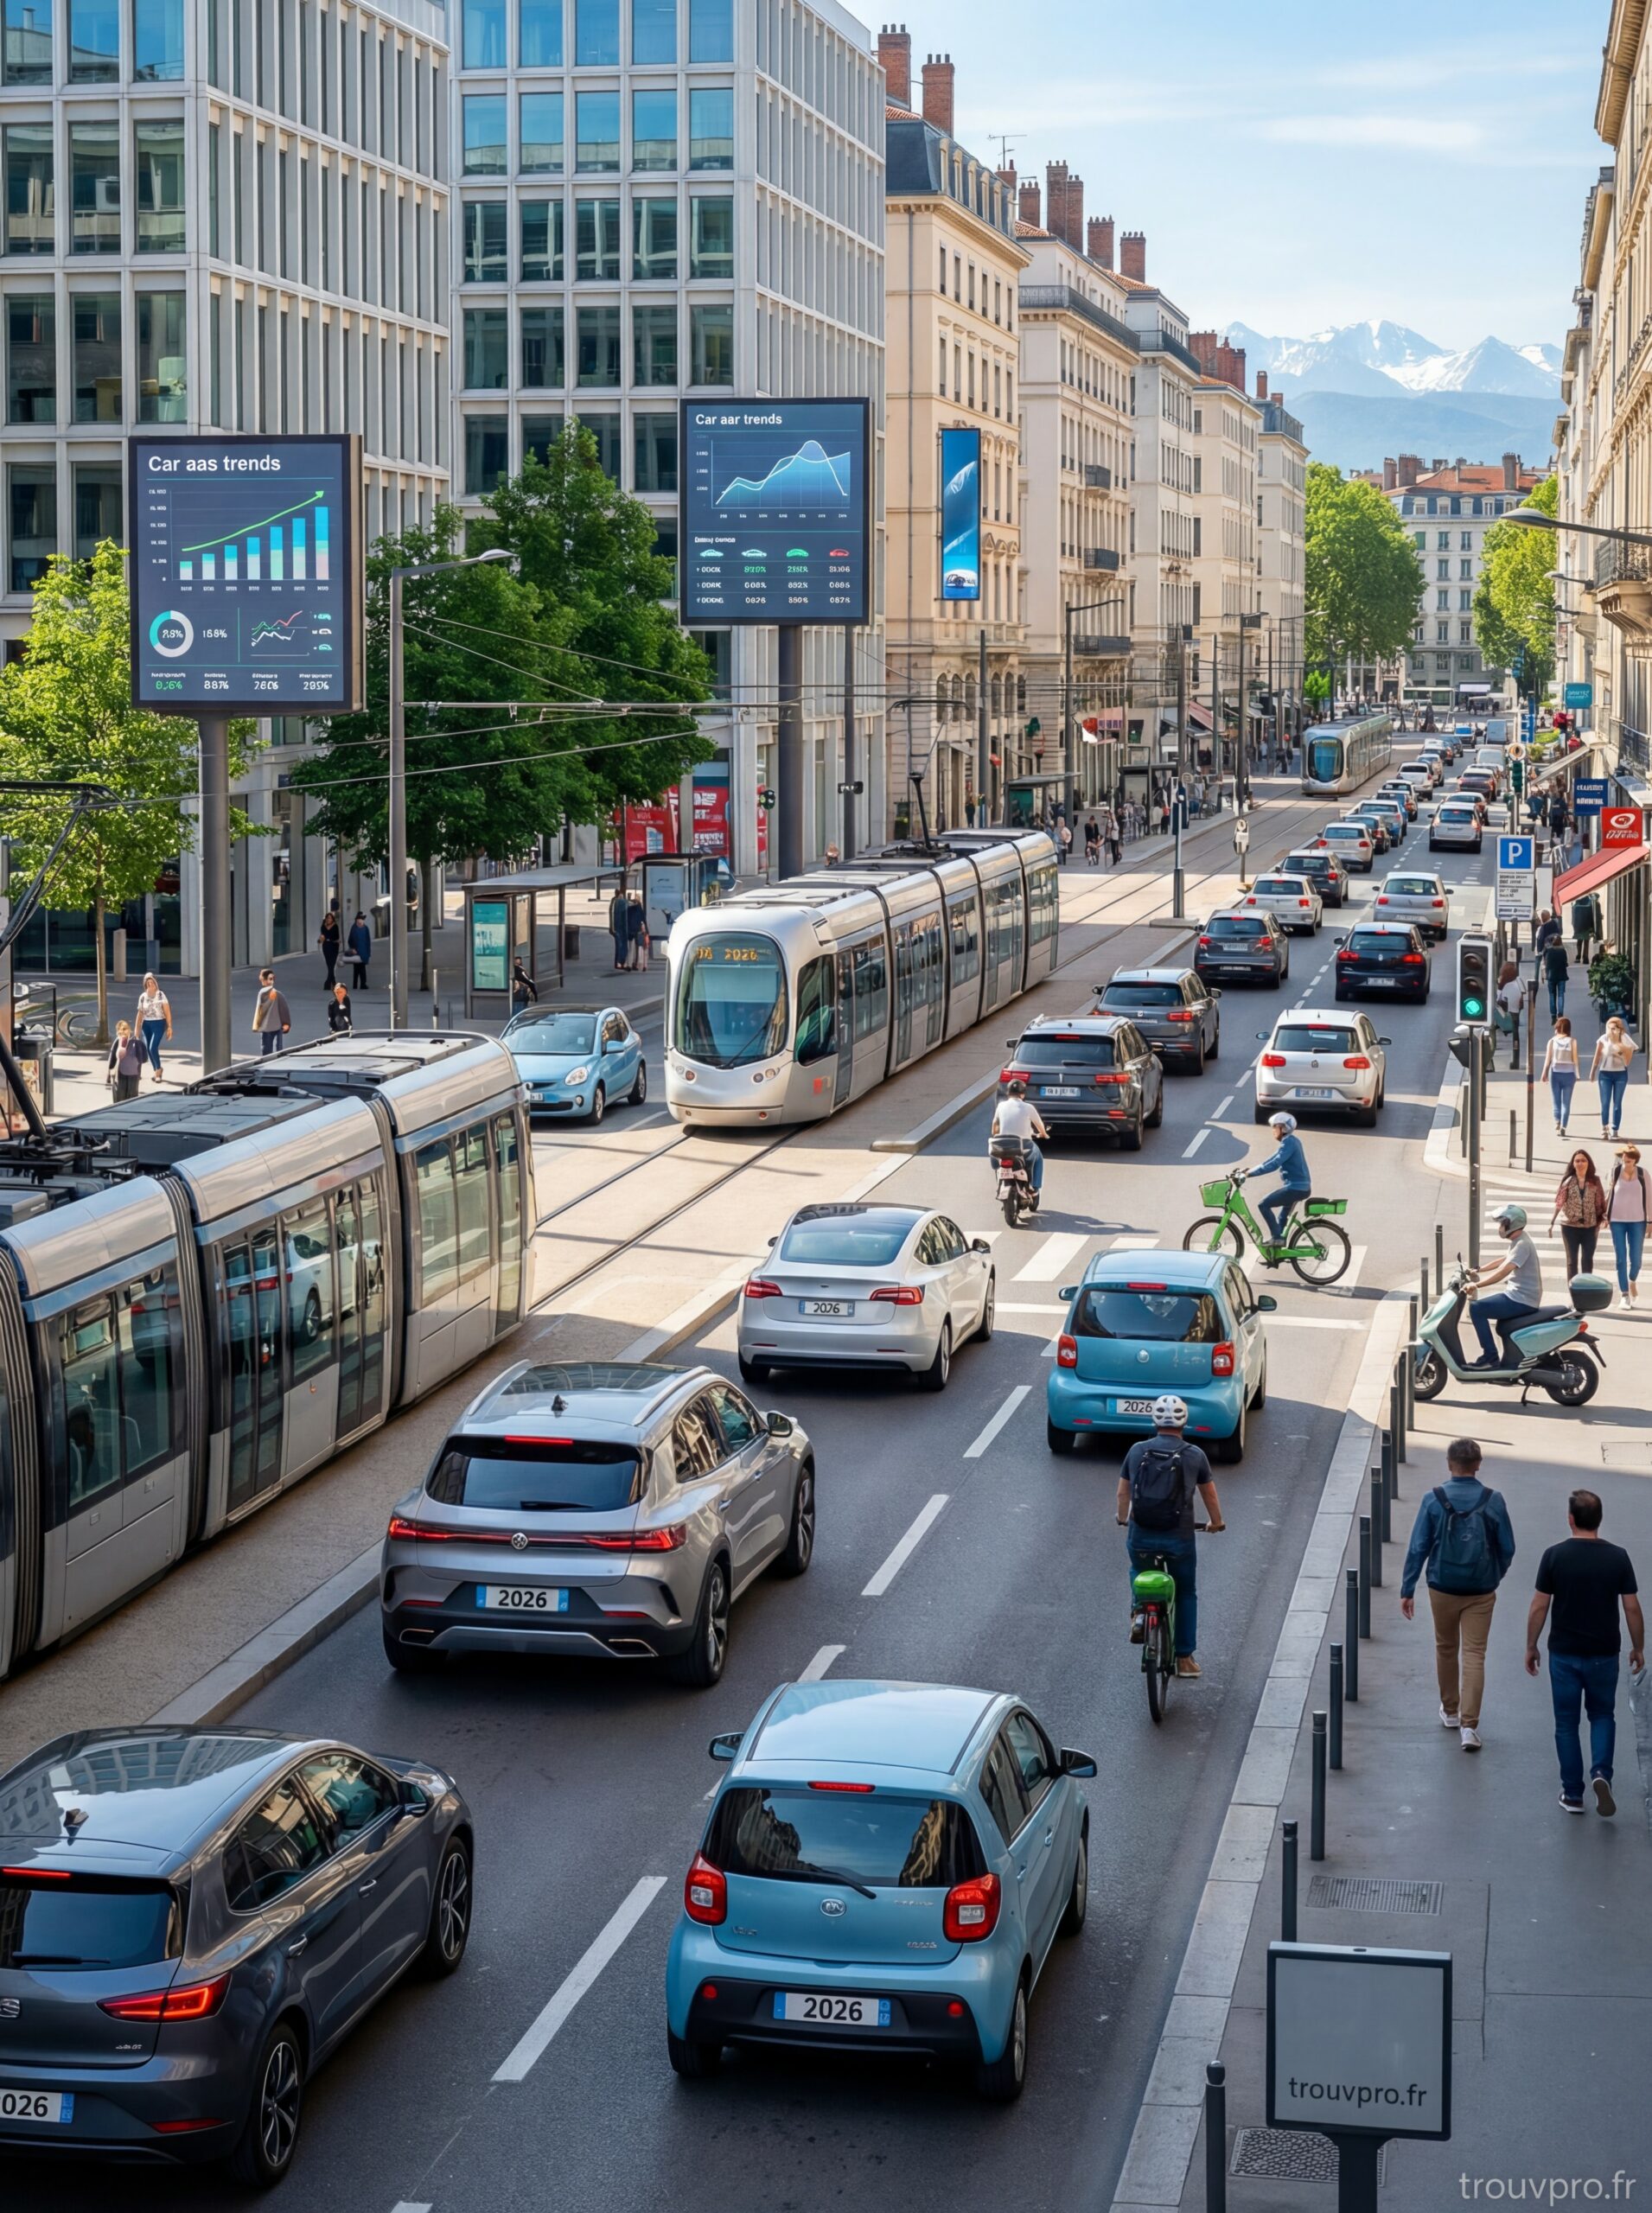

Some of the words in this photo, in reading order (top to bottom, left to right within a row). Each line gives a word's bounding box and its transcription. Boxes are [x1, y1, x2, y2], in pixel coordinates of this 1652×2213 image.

[695, 413, 717, 425] Car
[720, 416, 741, 425] aar
[744, 413, 782, 425] trends
[148, 456, 181, 472] Car
[186, 458, 218, 472] aas
[223, 454, 281, 472] trends
[1508, 842, 1523, 865] P
[813, 1302, 840, 1314] 2026
[1123, 1400, 1153, 1413] 2026
[498, 1589, 547, 1609] 2026
[803, 1997, 863, 2022] 2026
[1288, 2076, 1427, 2109] trouvpro.fr
[0, 2093, 48, 2118] 026
